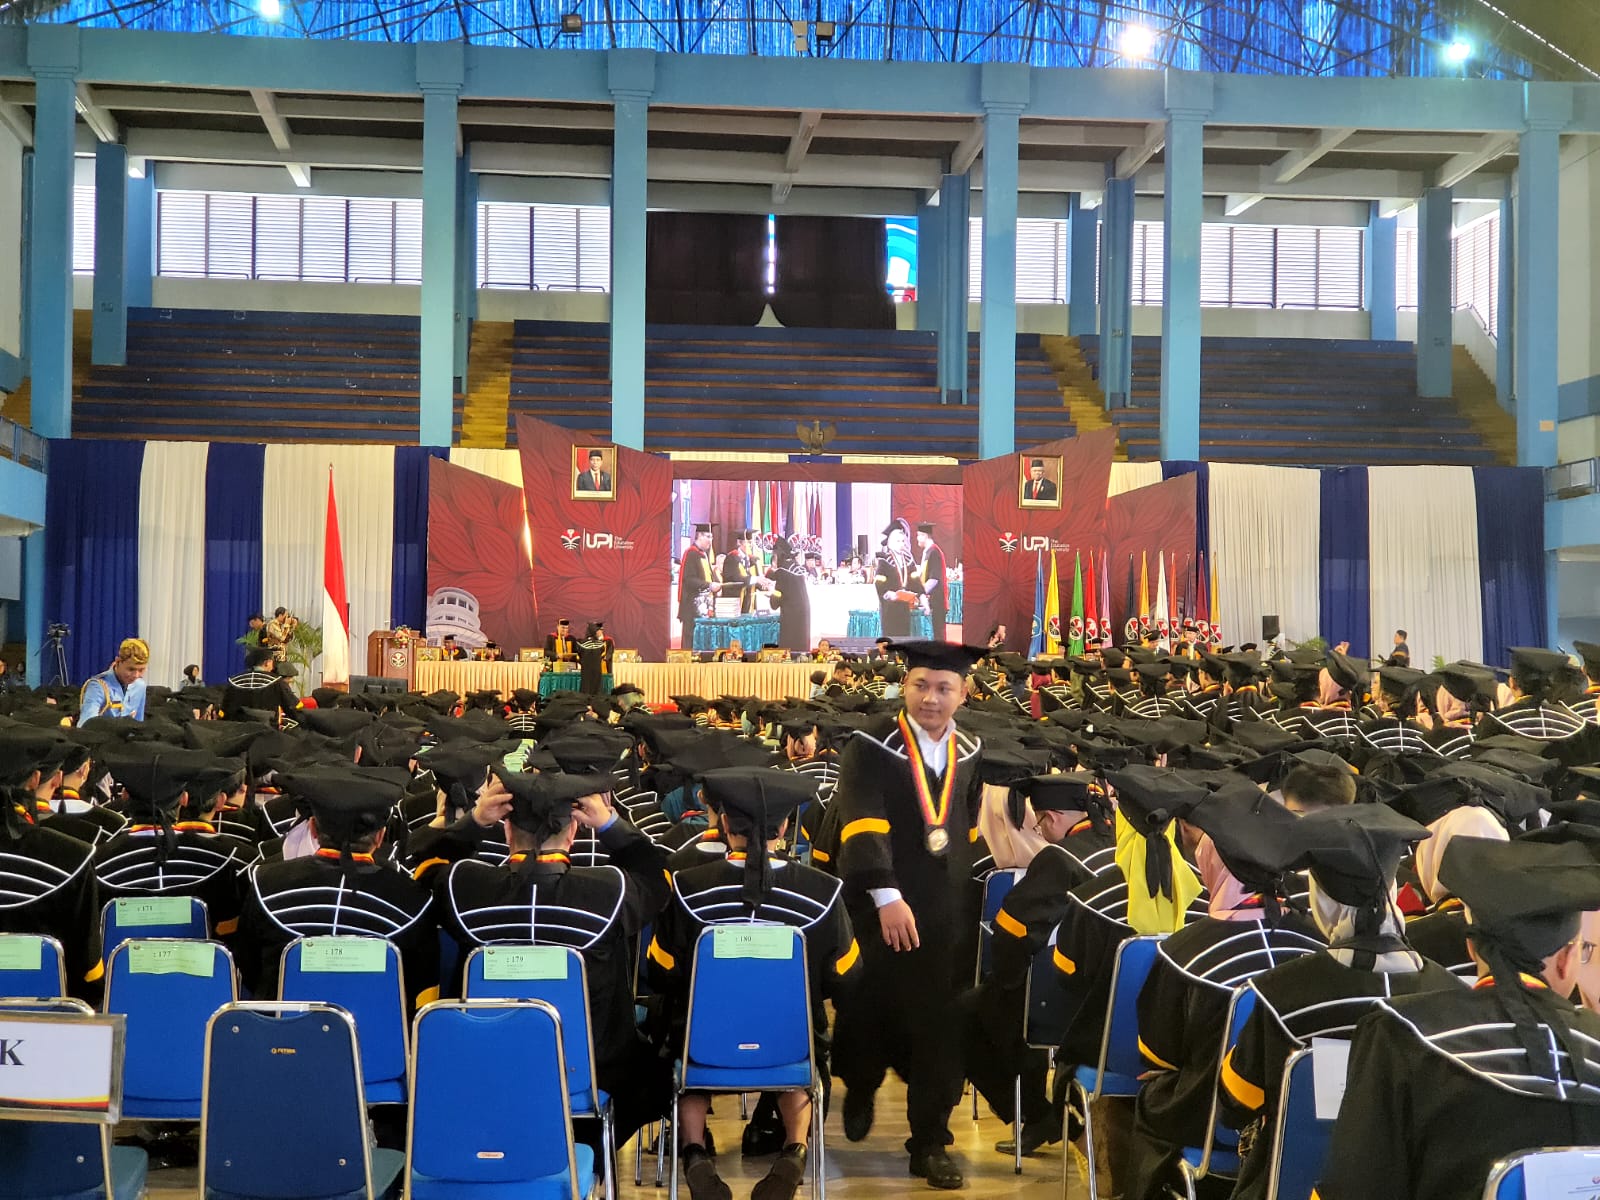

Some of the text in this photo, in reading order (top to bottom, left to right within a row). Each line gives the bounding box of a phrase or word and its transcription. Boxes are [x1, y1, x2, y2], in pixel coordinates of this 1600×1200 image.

[586, 533, 613, 549] UPI
[1023, 536, 1050, 551] UPI
[0, 1039, 25, 1066] K
